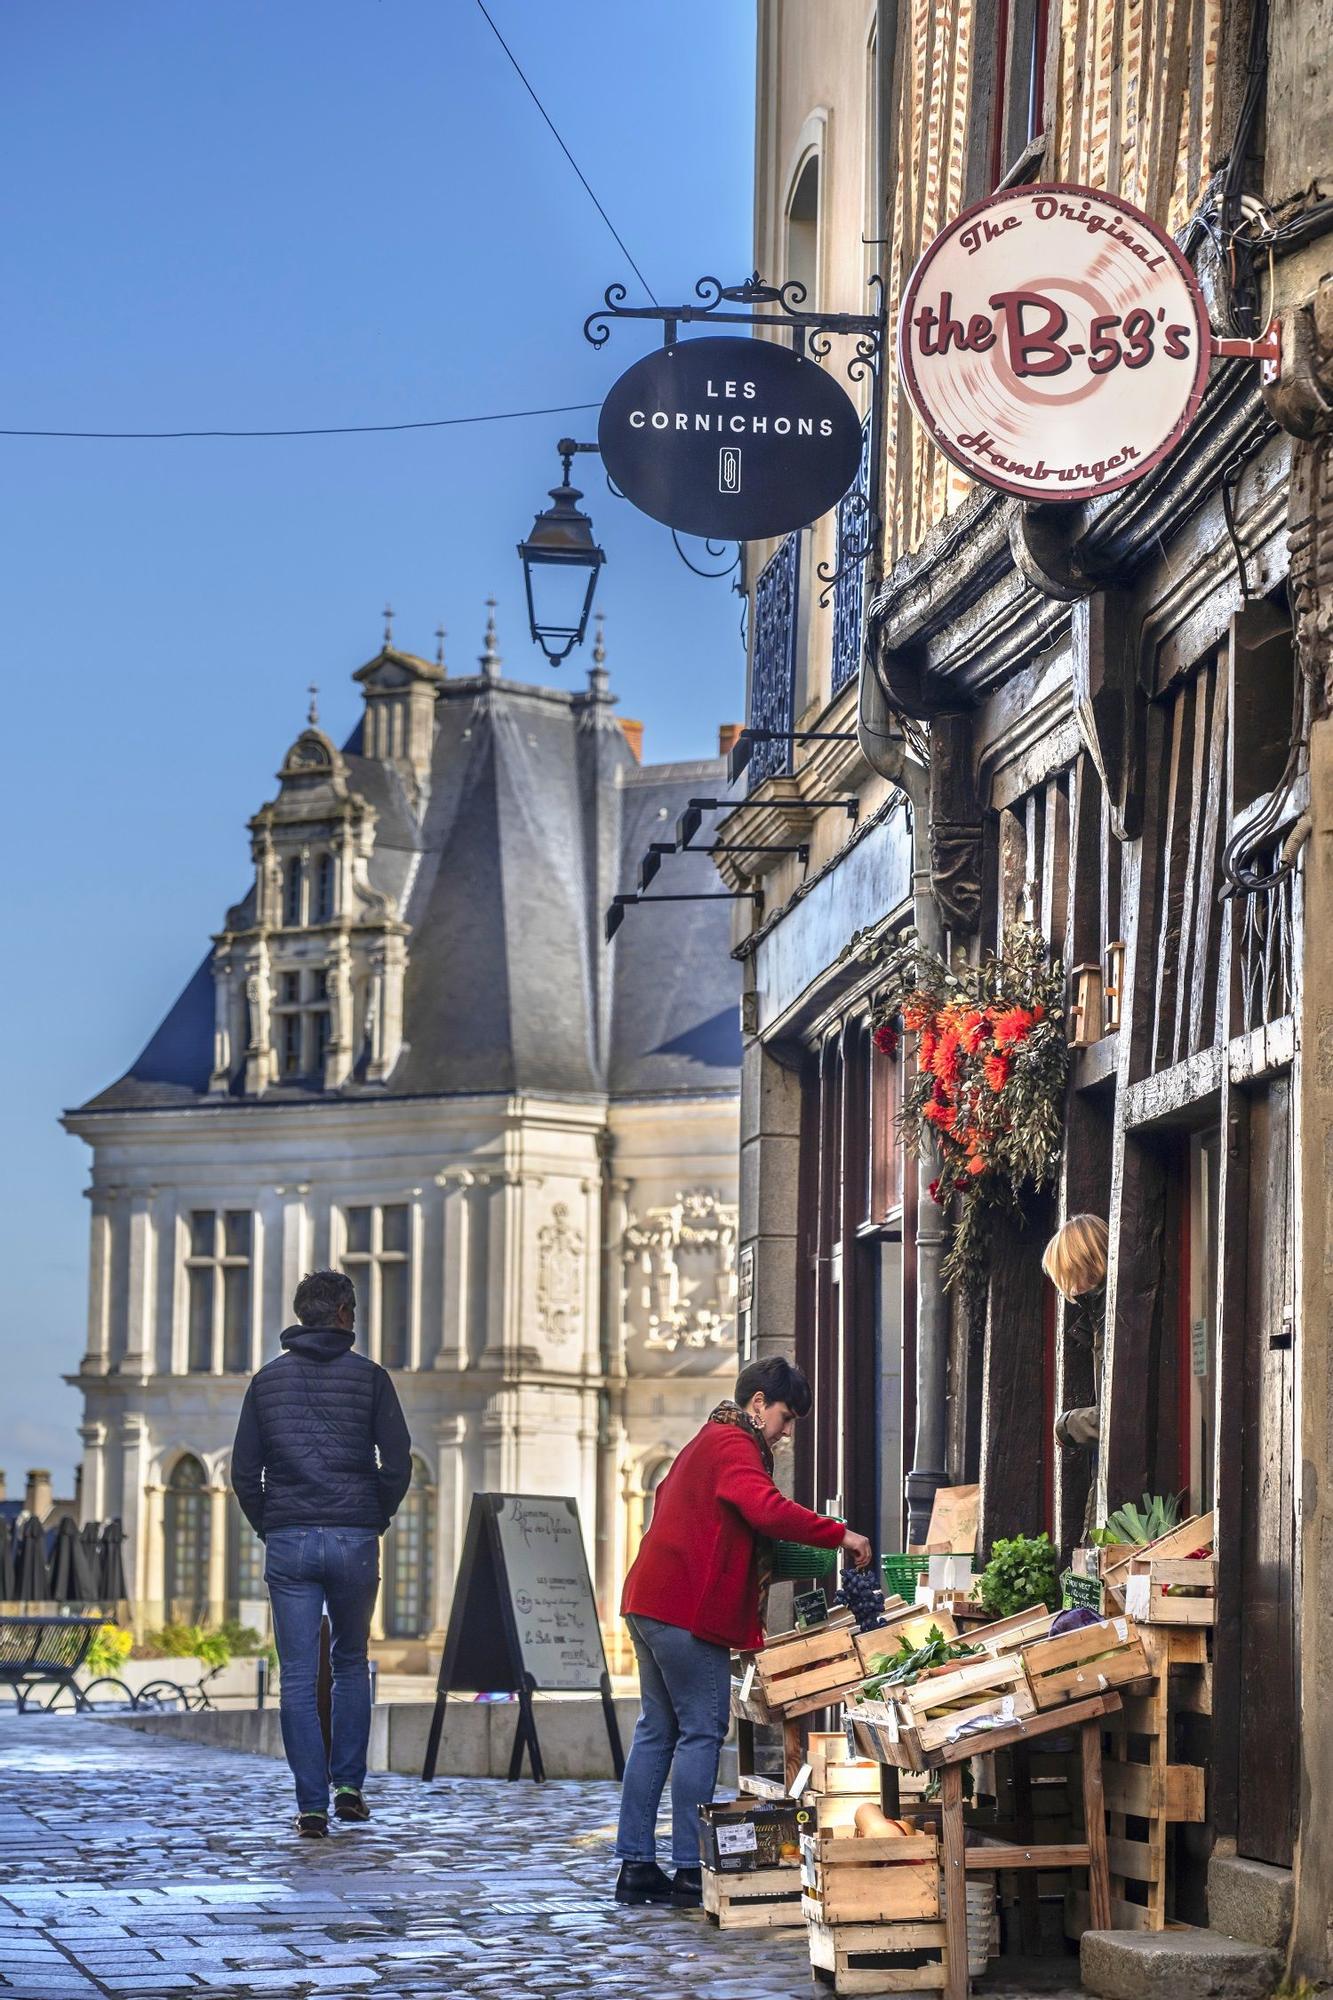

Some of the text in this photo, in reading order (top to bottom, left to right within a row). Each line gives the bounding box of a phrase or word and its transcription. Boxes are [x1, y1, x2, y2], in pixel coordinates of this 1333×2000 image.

[960, 196, 1167, 273] The Original
[913, 291, 1191, 377] the B-53's
[707, 380, 756, 399] LES
[629, 411, 833, 437] CORNICHONS
[957, 430, 1141, 482] Hamburger
